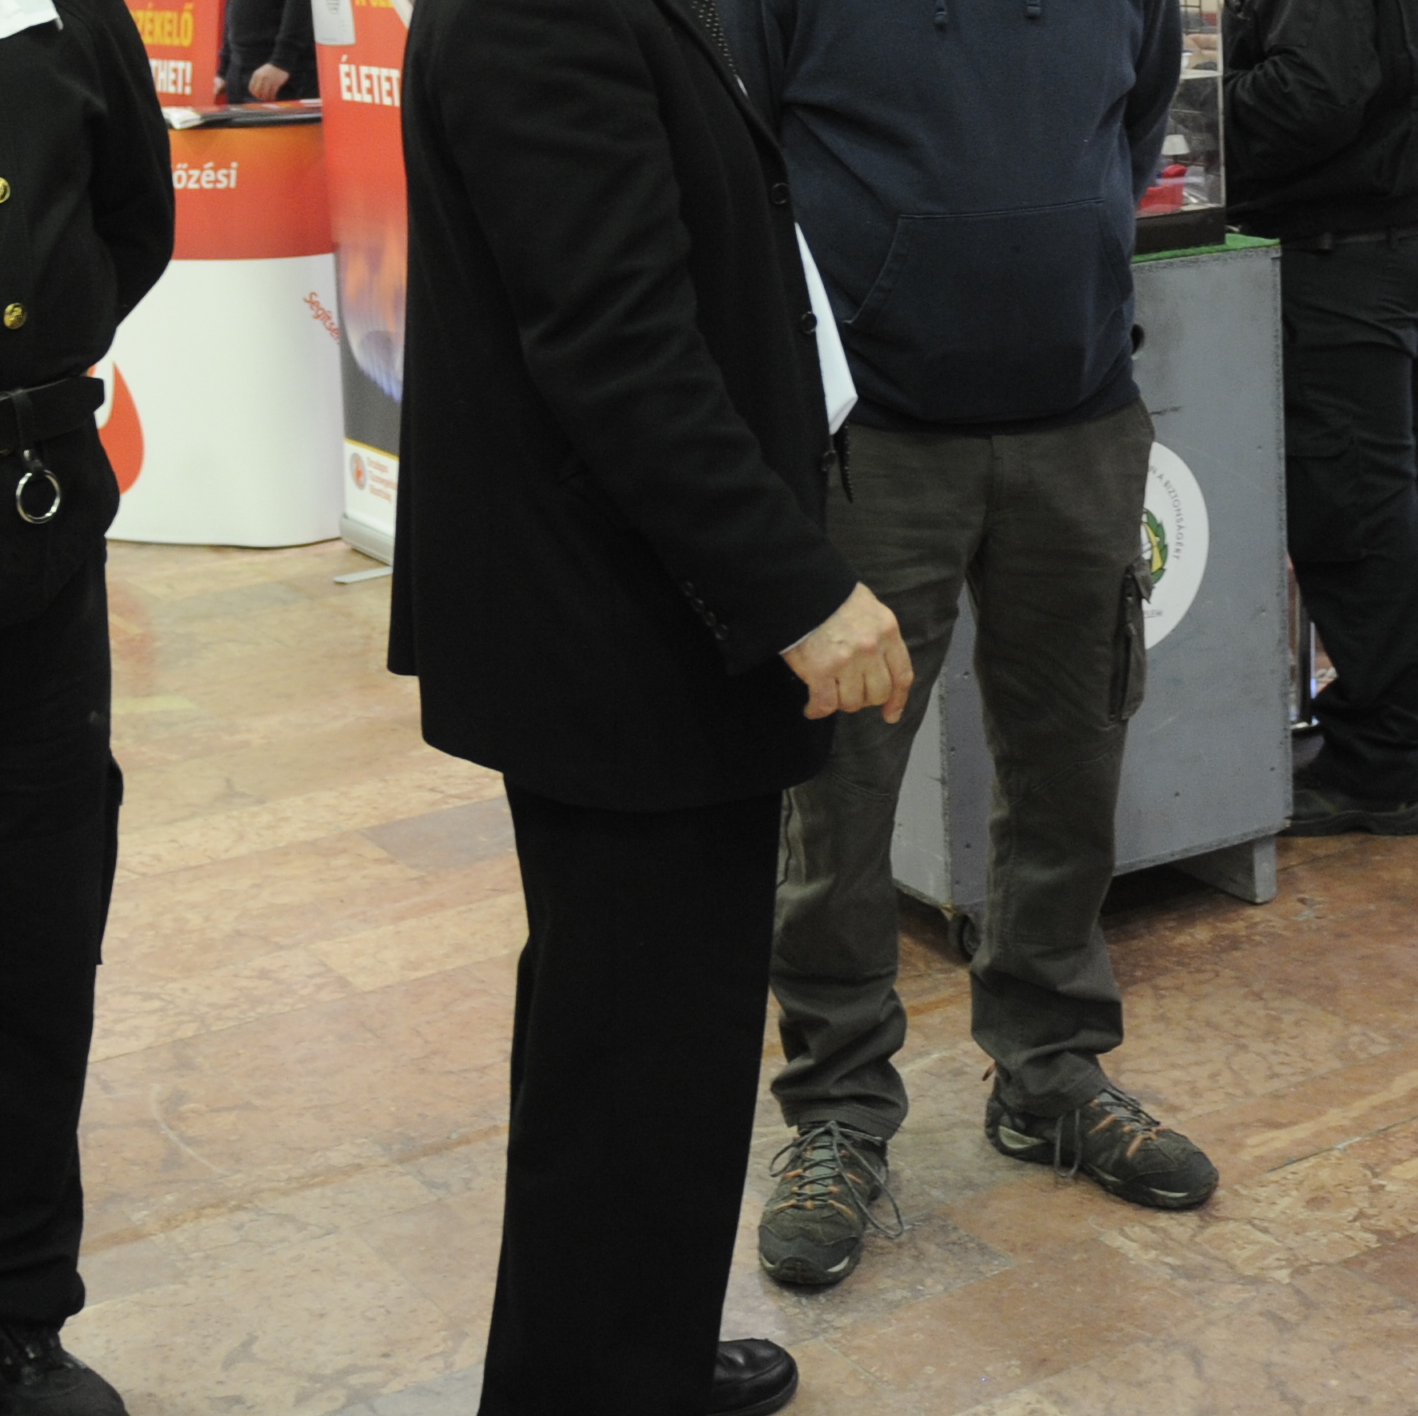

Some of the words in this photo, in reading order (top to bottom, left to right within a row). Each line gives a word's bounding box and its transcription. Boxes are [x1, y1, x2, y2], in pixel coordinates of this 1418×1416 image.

[130, 1, 194, 49] ZÉKELŐ
[148, 58, 193, 96] THET!
[338, 53, 401, 108] ÉLETET
[172, 160, 240, 191] őzési
